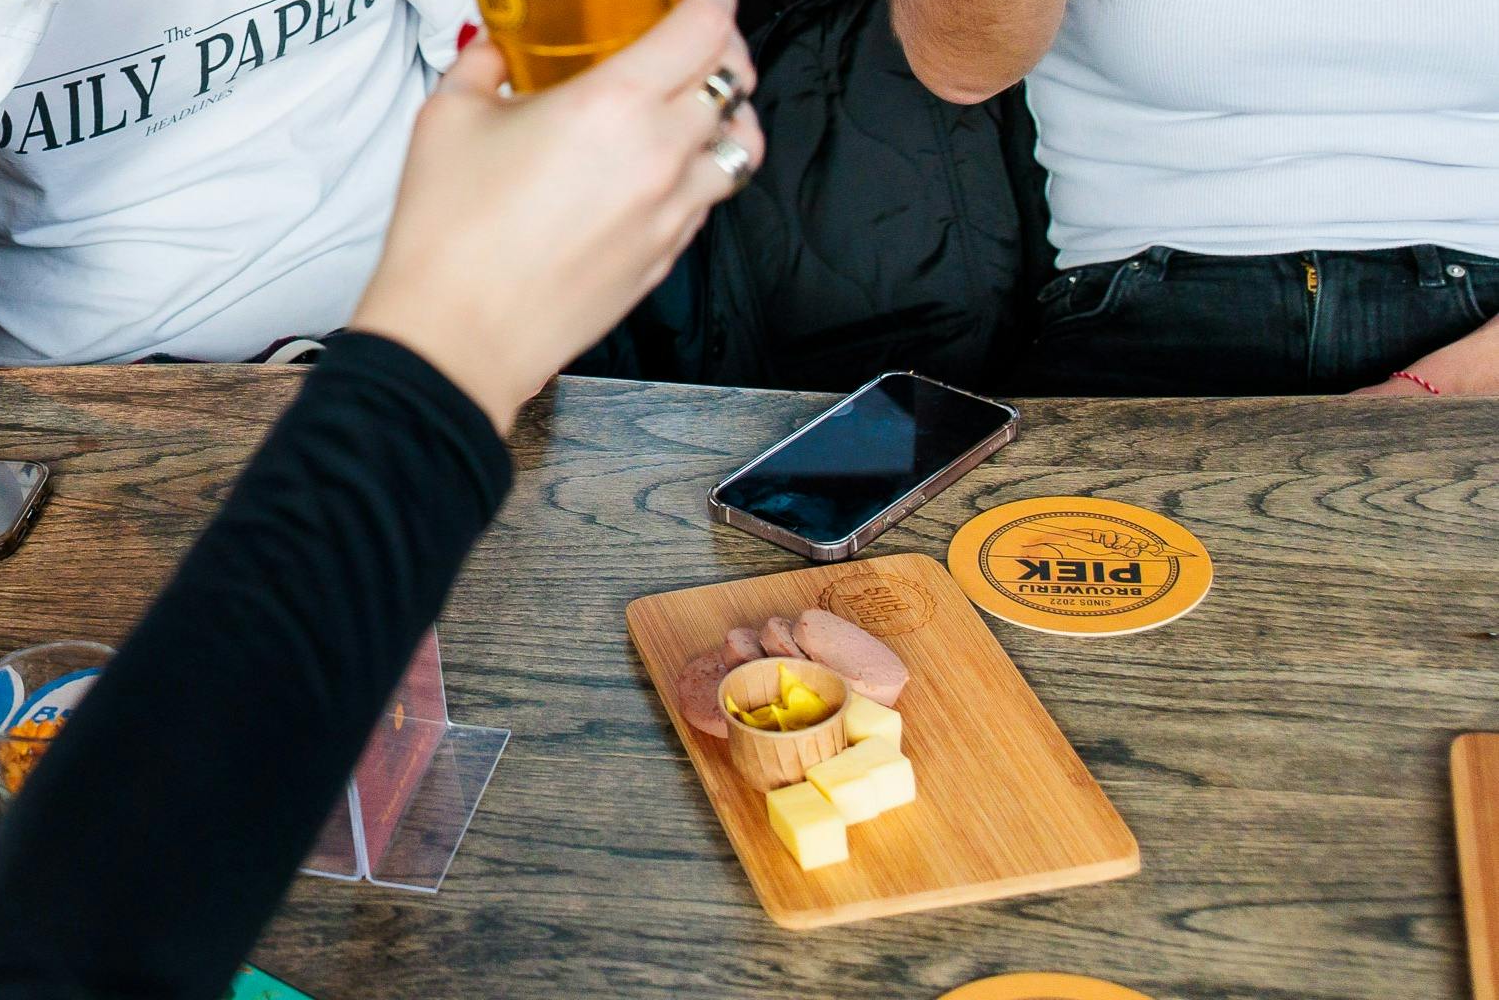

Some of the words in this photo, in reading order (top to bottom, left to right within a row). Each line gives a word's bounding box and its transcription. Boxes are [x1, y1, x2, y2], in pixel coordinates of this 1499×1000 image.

[164, 24, 193, 44] The
[145, 87, 234, 137] HEADLINES
[1016, 559, 1142, 584] PIEK
[863, 586, 910, 613] BUS
[1019, 584, 1143, 596] BROUWERIJ
[1050, 598, 1076, 606] 2022
[841, 594, 890, 623] BREW
